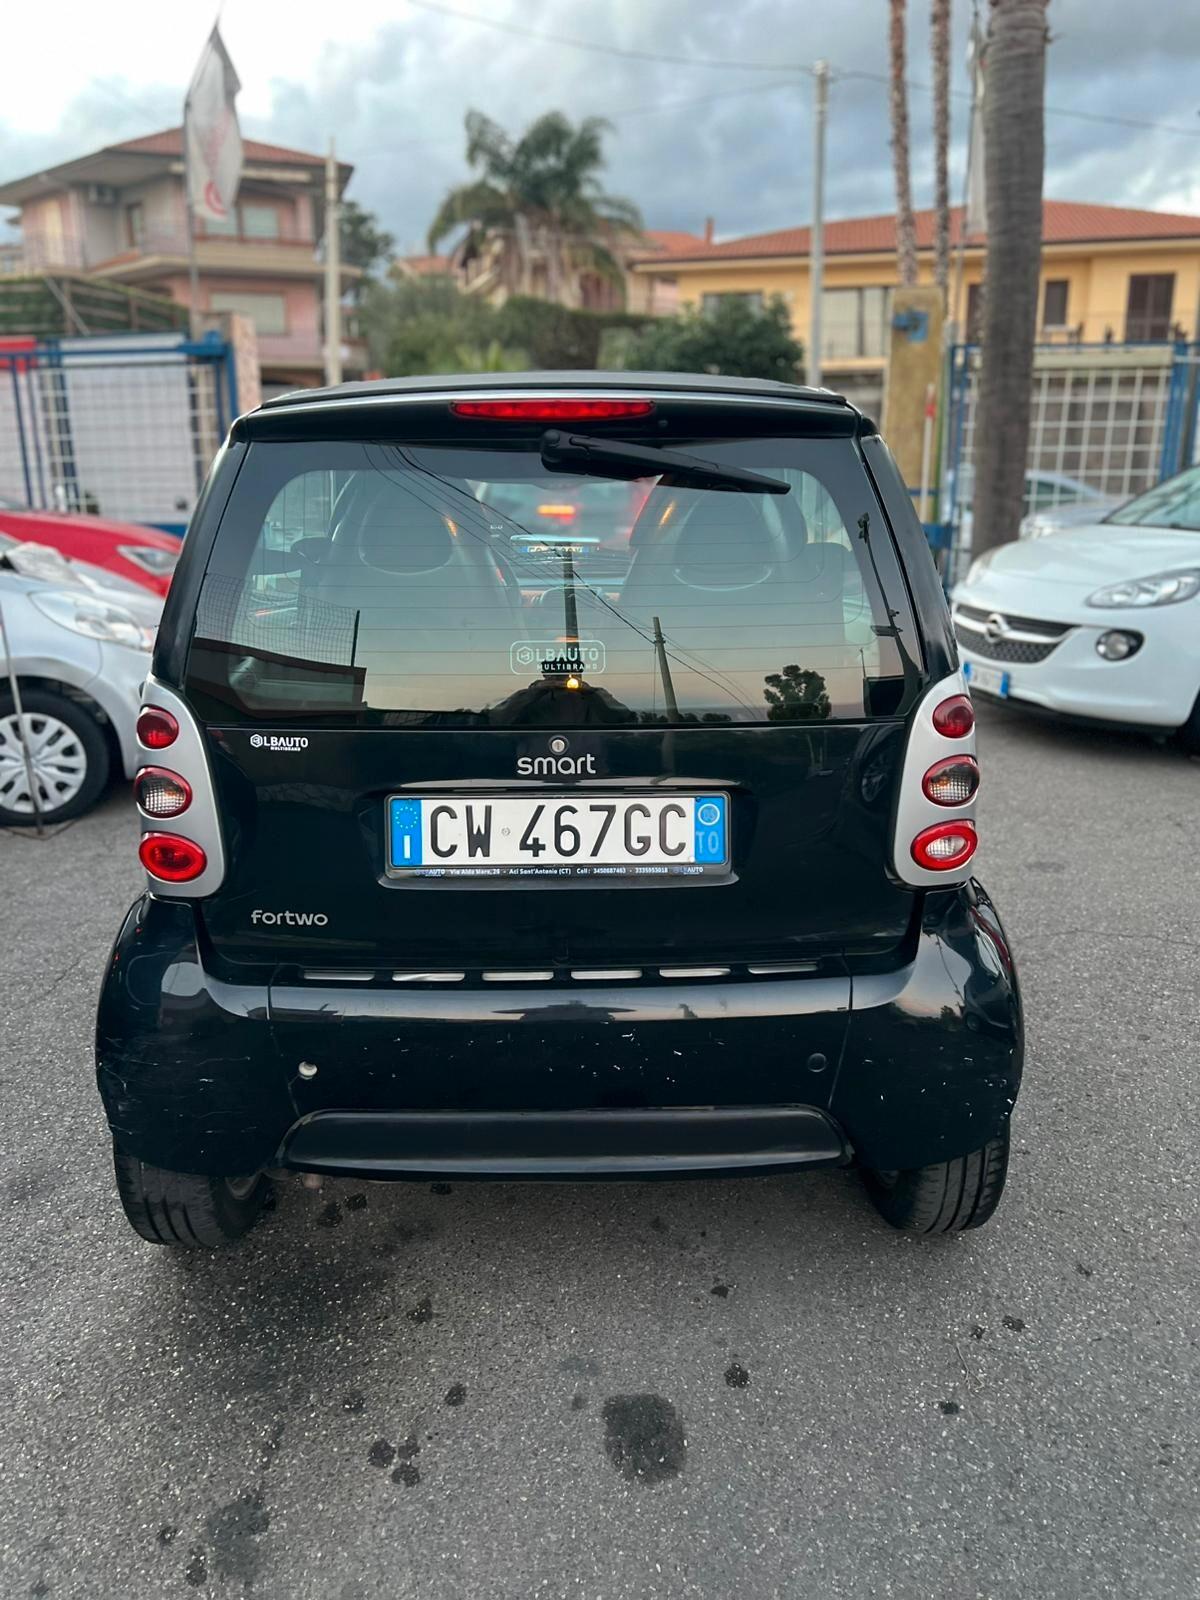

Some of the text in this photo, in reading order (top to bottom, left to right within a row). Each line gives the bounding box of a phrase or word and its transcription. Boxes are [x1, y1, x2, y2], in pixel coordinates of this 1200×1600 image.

[537, 663, 598, 671] MULTIBRAND
[517, 753, 597, 775] smart
[430, 803, 687, 858] CW 467GC
[695, 831, 720, 854] TO
[251, 910, 329, 926] fortwo
